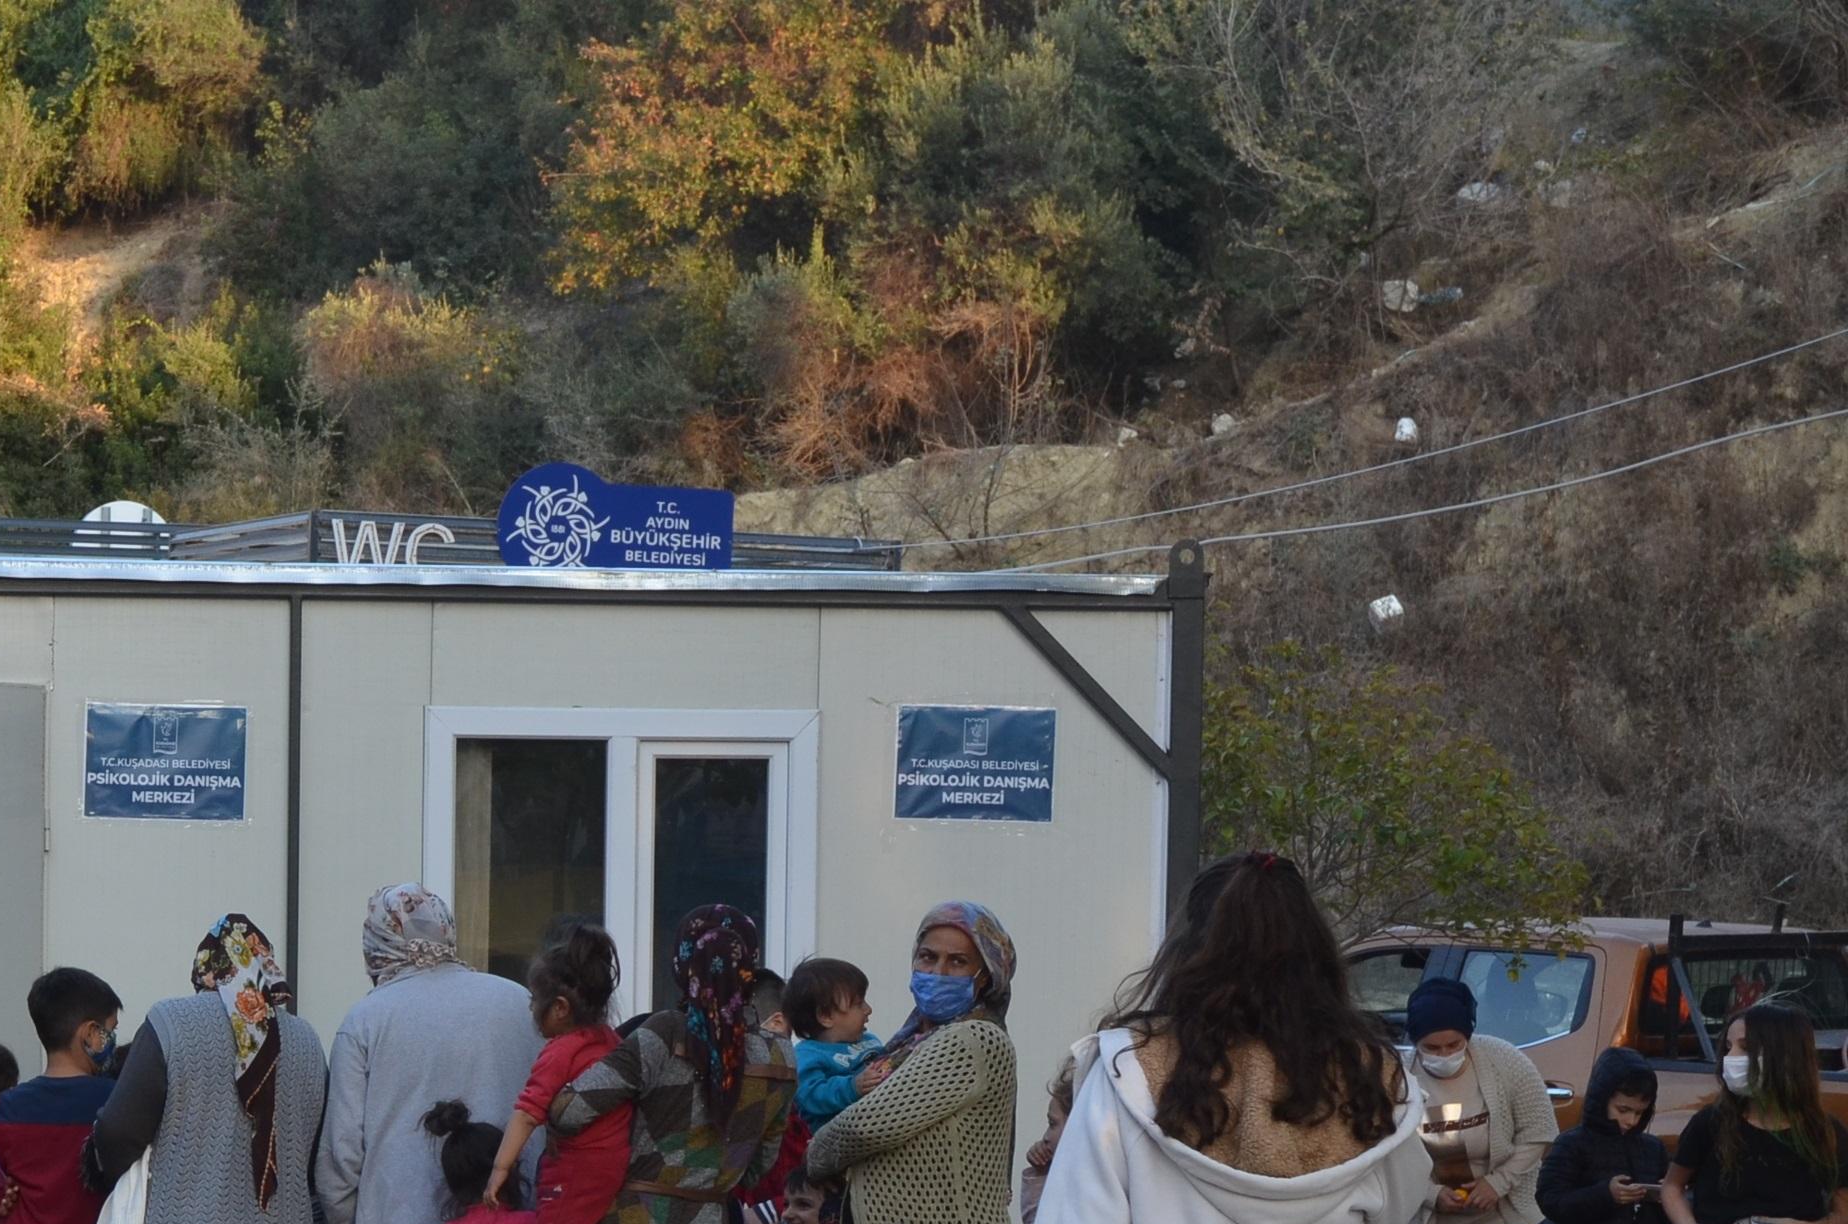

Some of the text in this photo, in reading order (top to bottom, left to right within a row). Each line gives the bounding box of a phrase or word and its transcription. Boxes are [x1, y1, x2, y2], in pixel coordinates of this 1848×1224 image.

[656, 501, 681, 514] T.C.
[645, 517, 690, 530] AYDIN
[610, 529, 721, 551] BÜYÜKŞEHİR
[625, 549, 706, 566] BELEDİYESİ
[172, 758, 231, 769] BELEDİYESİ
[982, 759, 1040, 771] BELEDİYESİ
[87, 769, 242, 791] PSİKOLOJİK DANIŞMA
[898, 771, 1050, 792] PSİKOLOJİK DANIŞMA
[131, 789, 195, 804] MERKEZİ
[941, 790, 1005, 805] MERKEZİ
